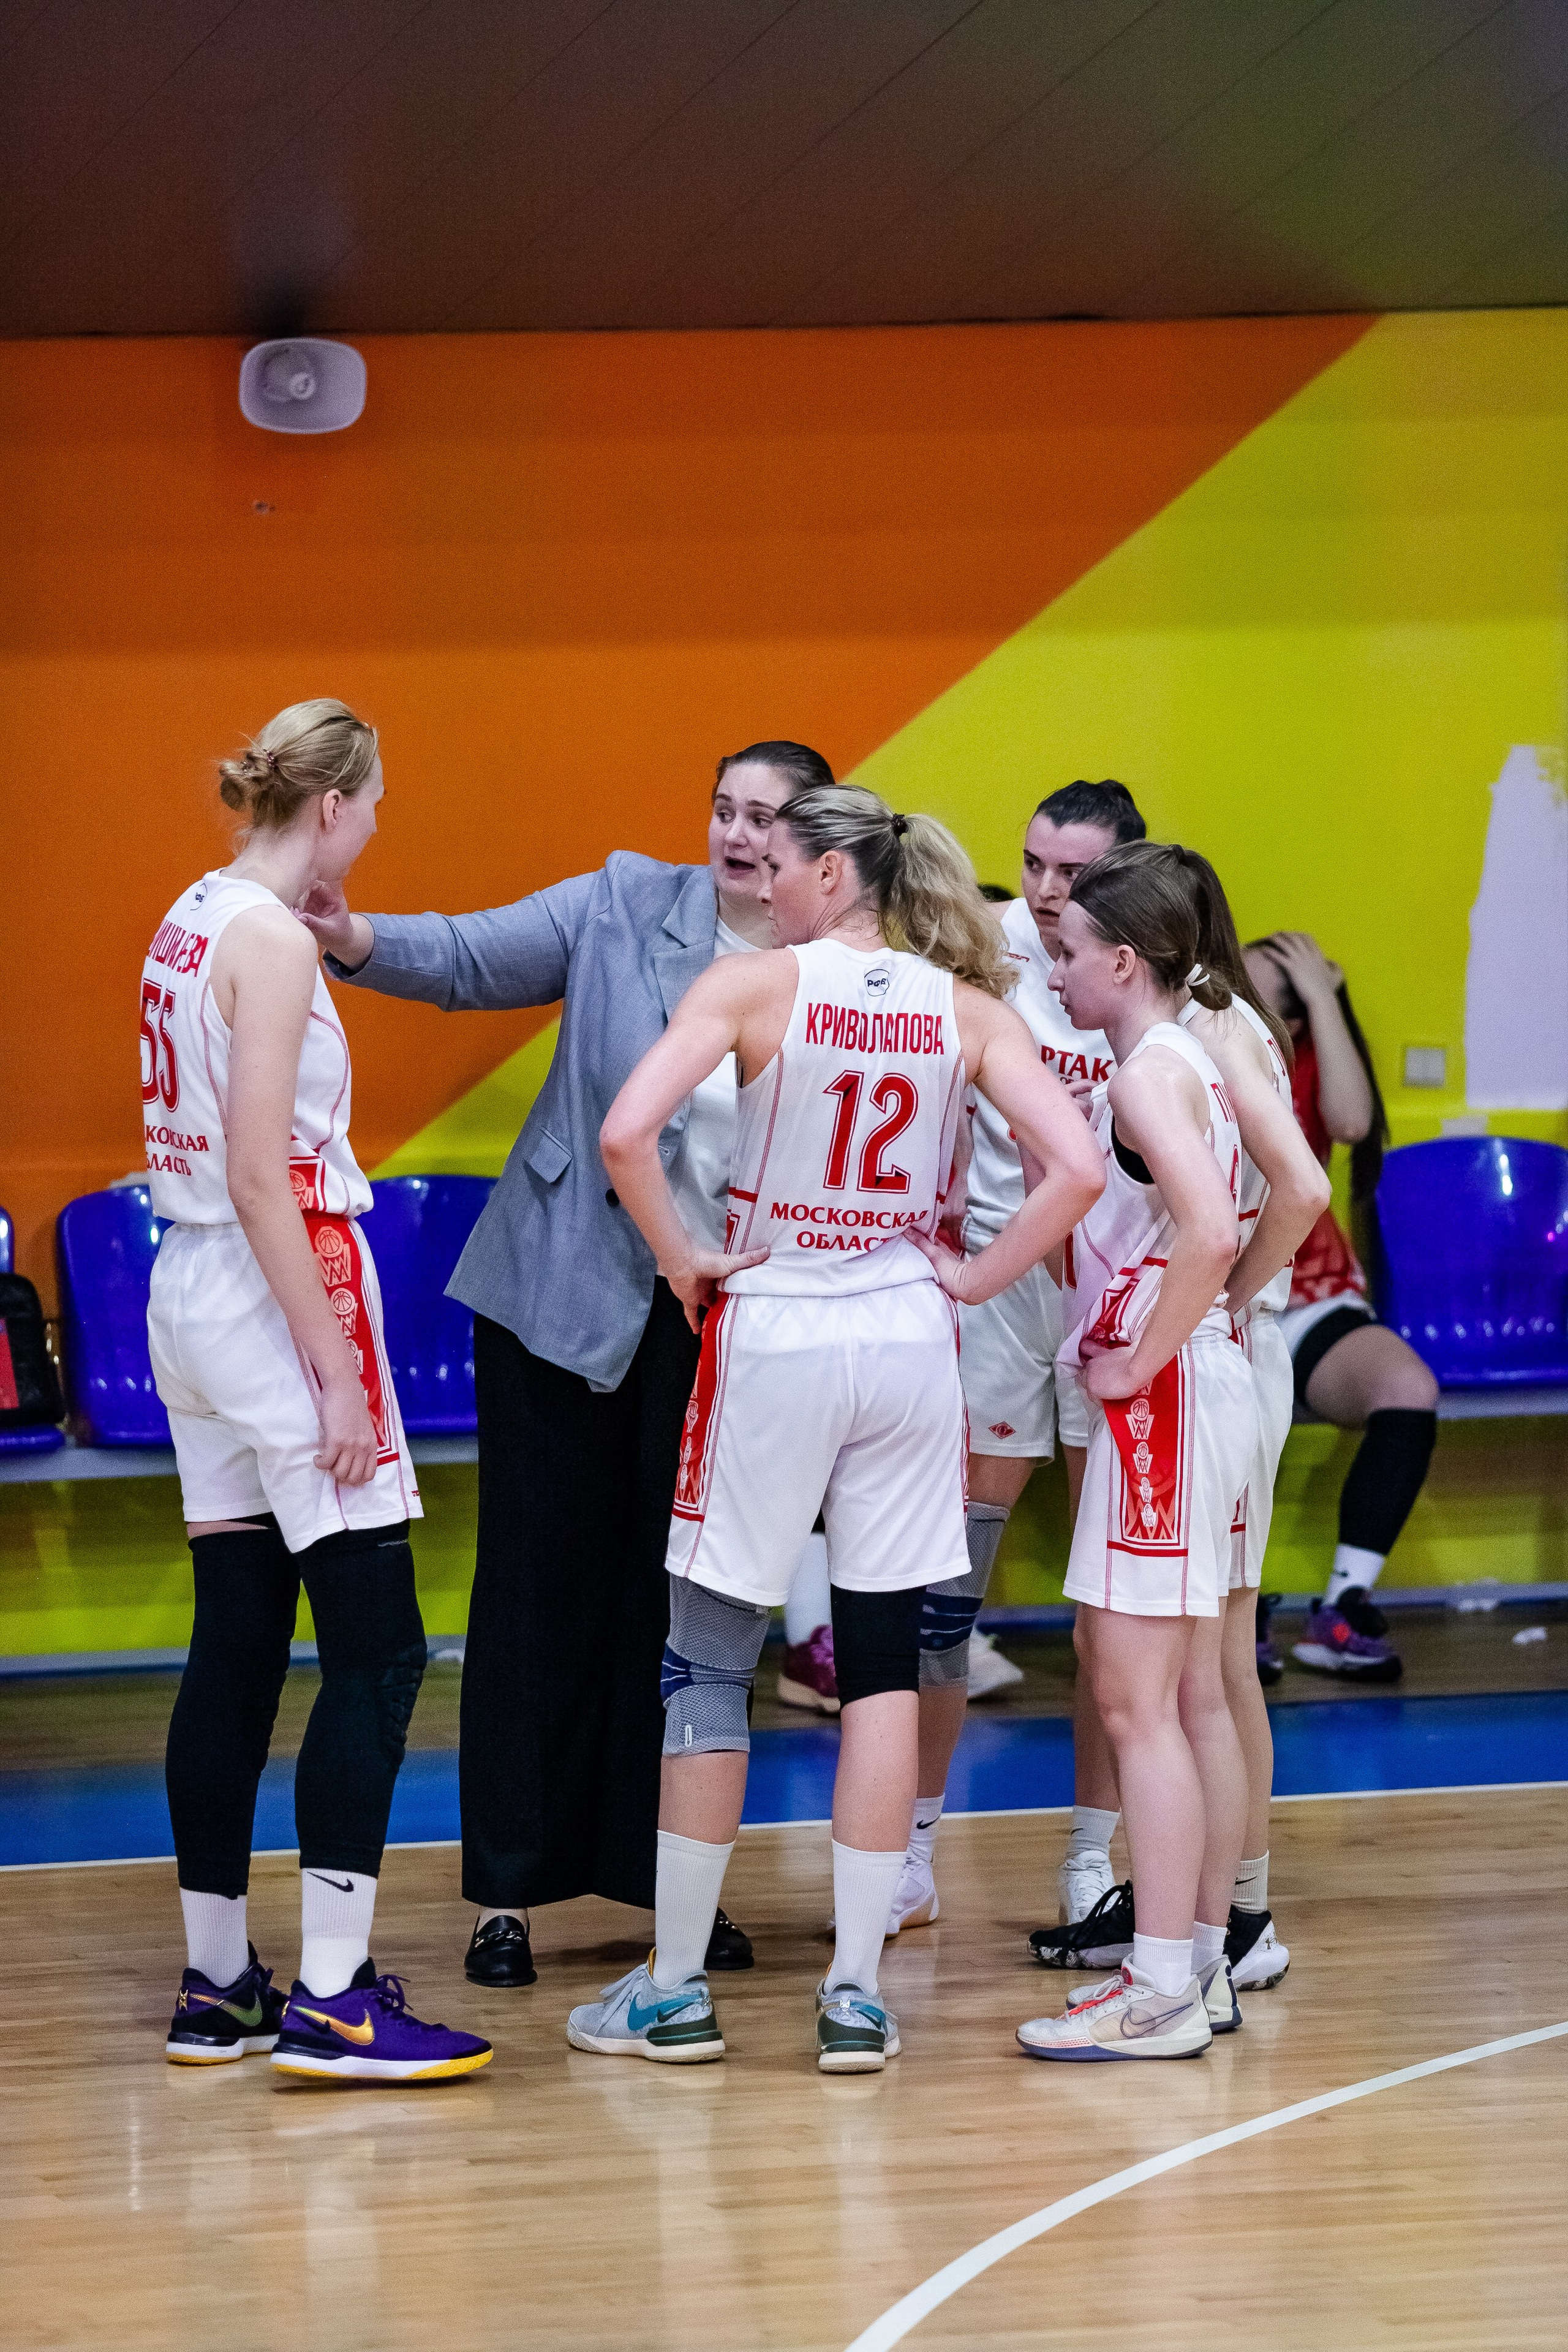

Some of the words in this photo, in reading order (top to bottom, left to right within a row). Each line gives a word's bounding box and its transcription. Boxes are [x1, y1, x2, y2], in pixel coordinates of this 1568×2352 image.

[140, 978, 179, 1113] 55
[806, 1003, 944, 1055] КРИВОЛАПОВА
[822, 1069, 919, 1194] 12
